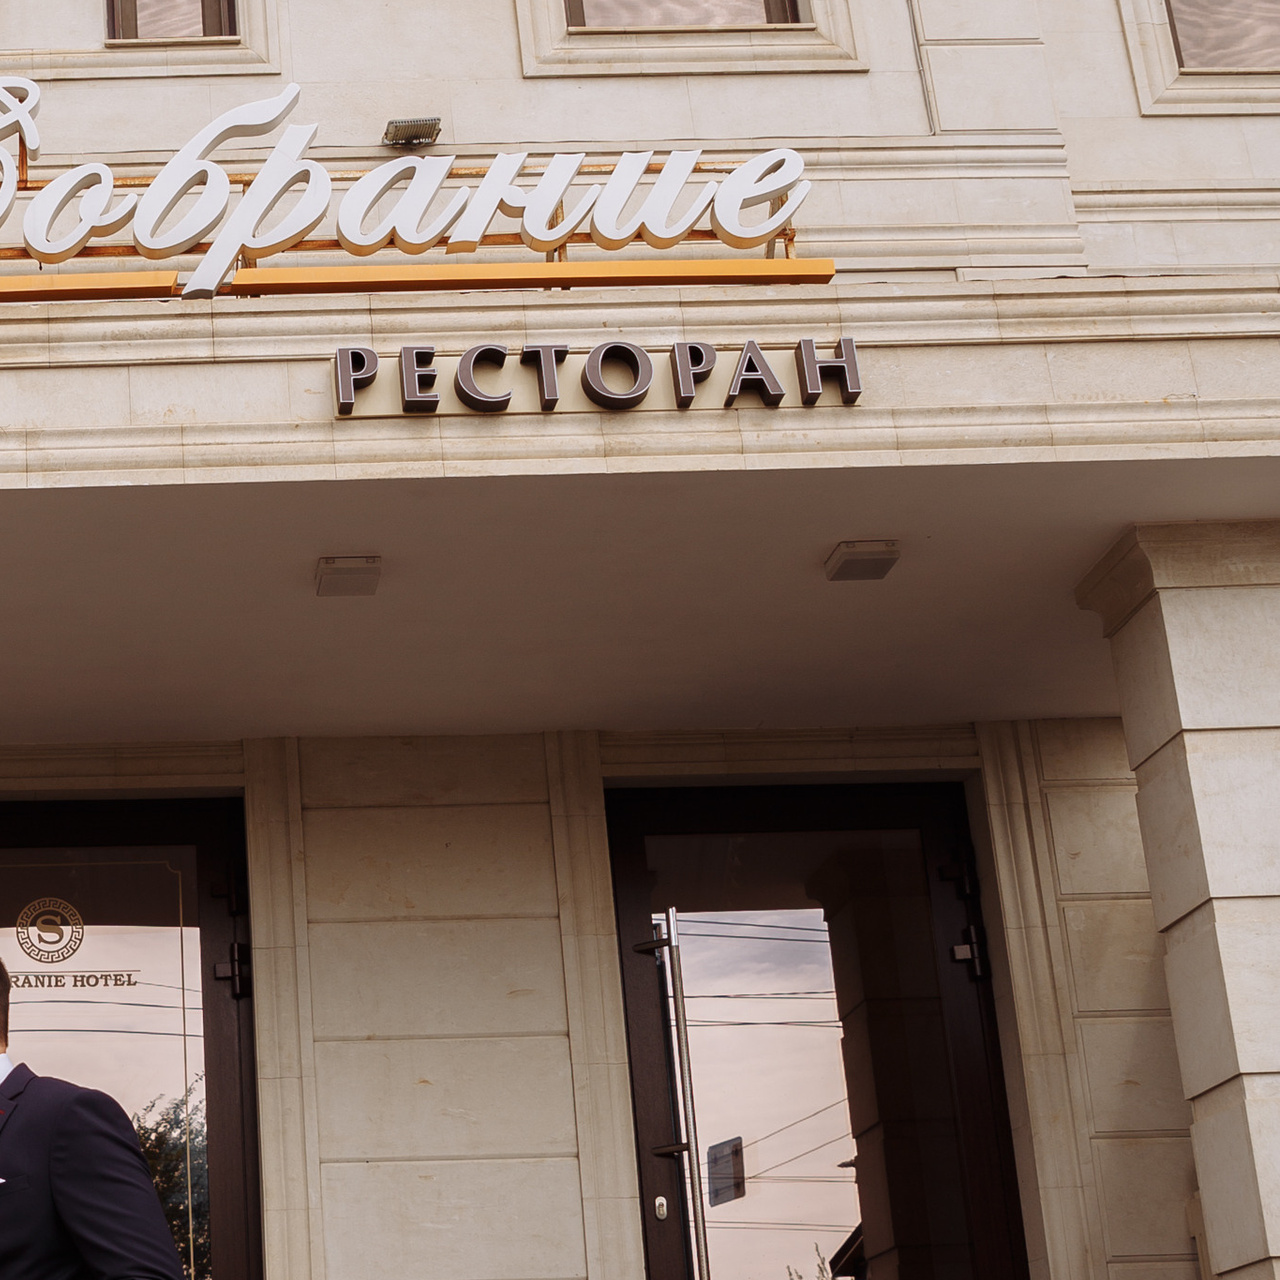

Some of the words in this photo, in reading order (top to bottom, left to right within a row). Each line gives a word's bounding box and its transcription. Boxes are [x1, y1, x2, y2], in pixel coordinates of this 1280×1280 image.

[334, 336, 863, 416] РЕСТОРАН
[35, 914, 65, 945] S
[10, 974, 66, 988] RANIE
[72, 973, 138, 988] HOTEL
